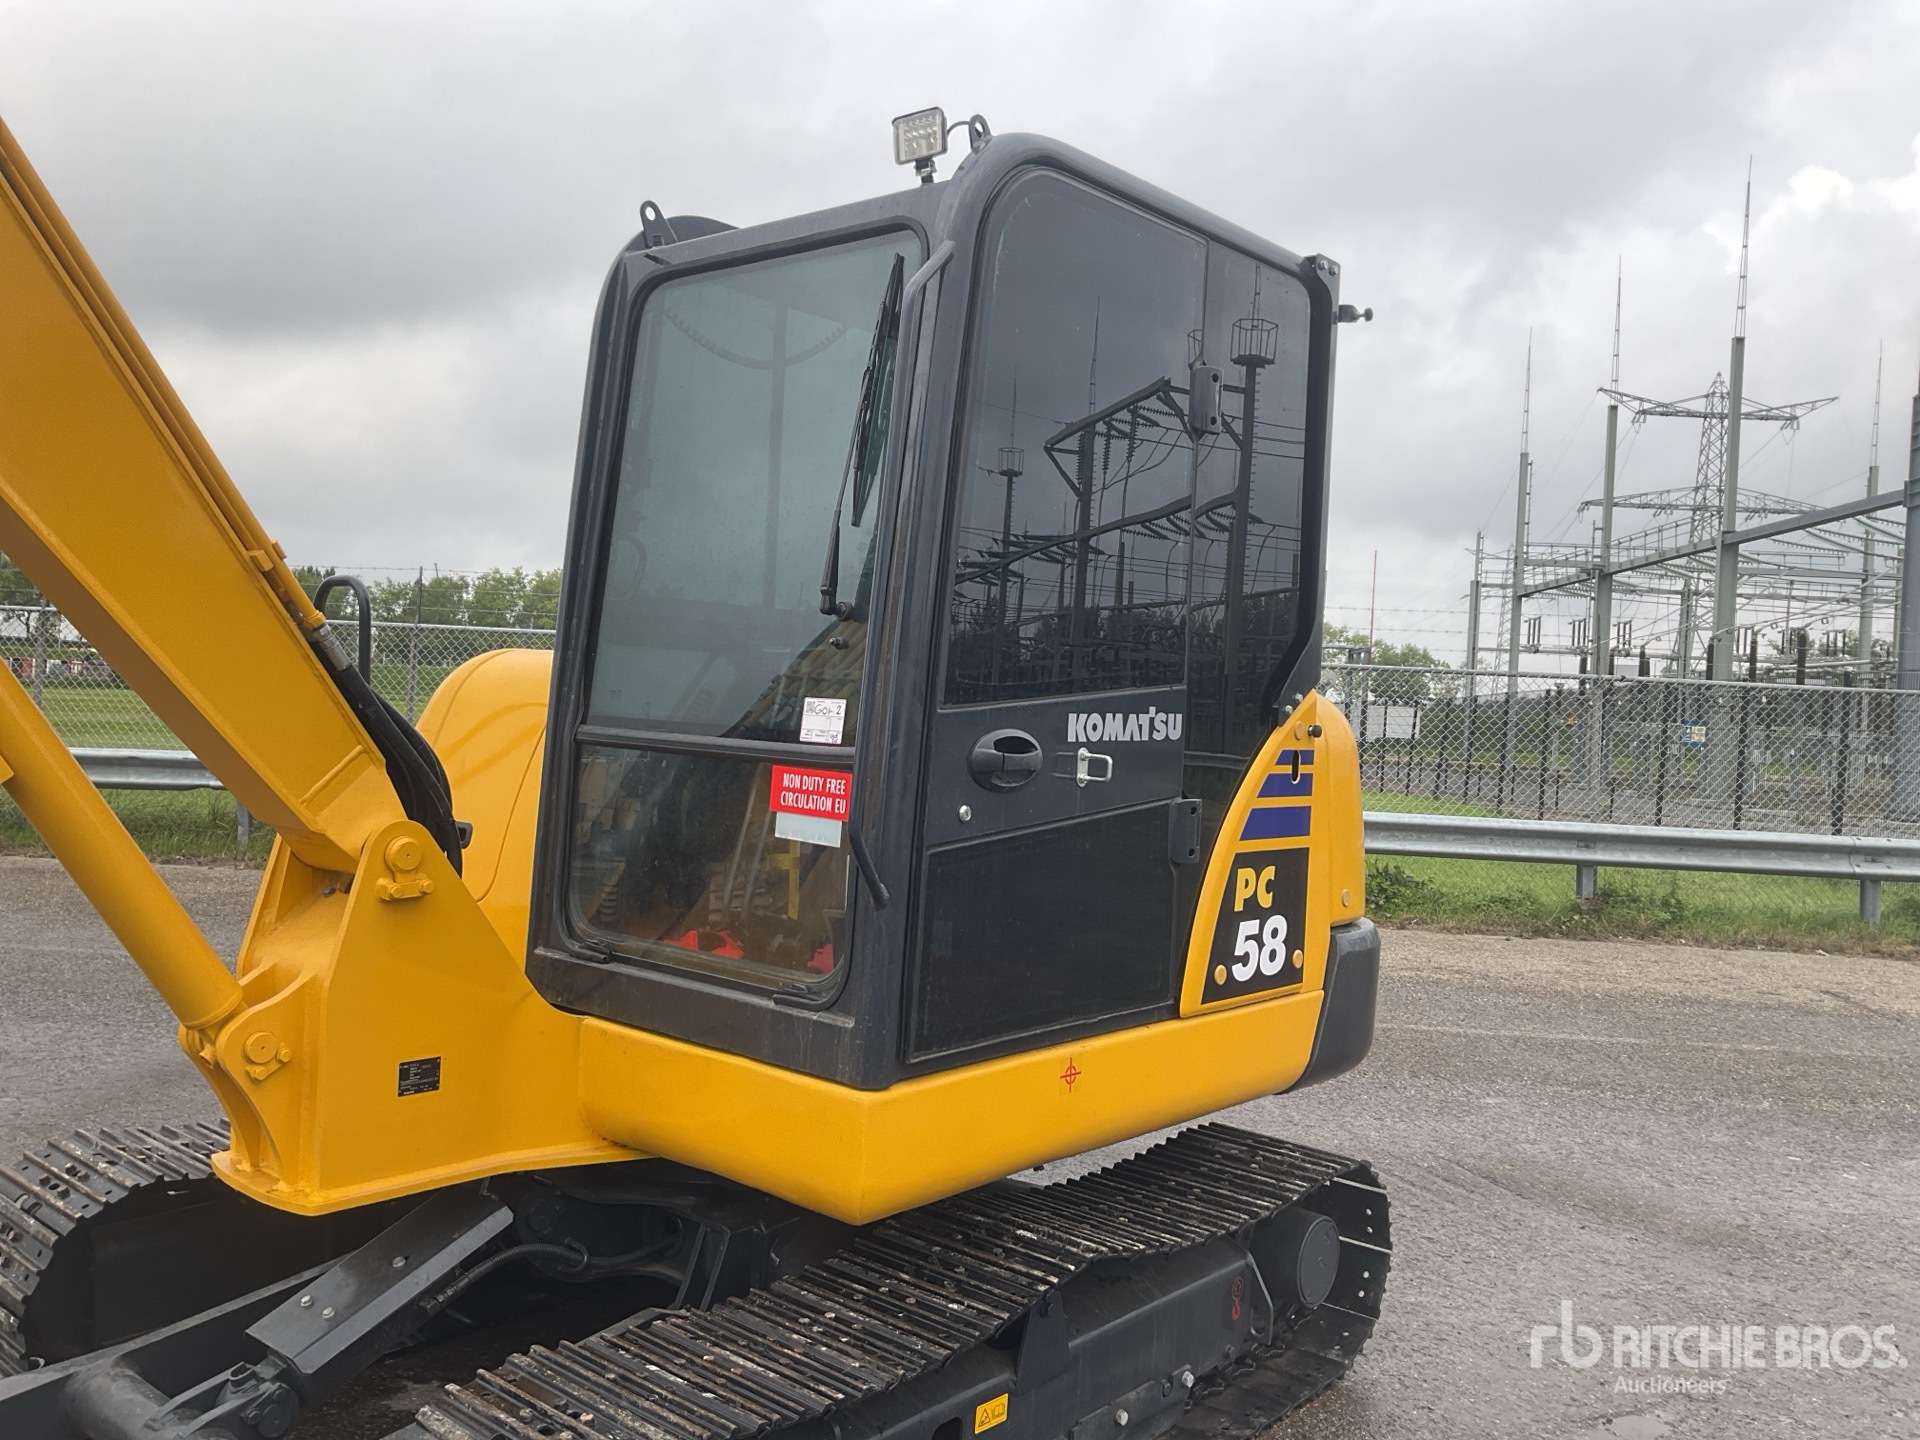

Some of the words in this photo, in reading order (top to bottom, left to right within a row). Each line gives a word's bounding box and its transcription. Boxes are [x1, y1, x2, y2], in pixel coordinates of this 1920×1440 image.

[836, 705, 842, 715] 2
[1067, 706, 1183, 743] KOMATSU
[783, 772, 801, 789] NON
[802, 775, 824, 792] DUTY
[826, 778, 846, 795] FREE
[780, 791, 832, 812] CIRCULATION
[834, 798, 847, 814] EU
[1233, 865, 1276, 912] PC
[1231, 914, 1288, 982] 58
